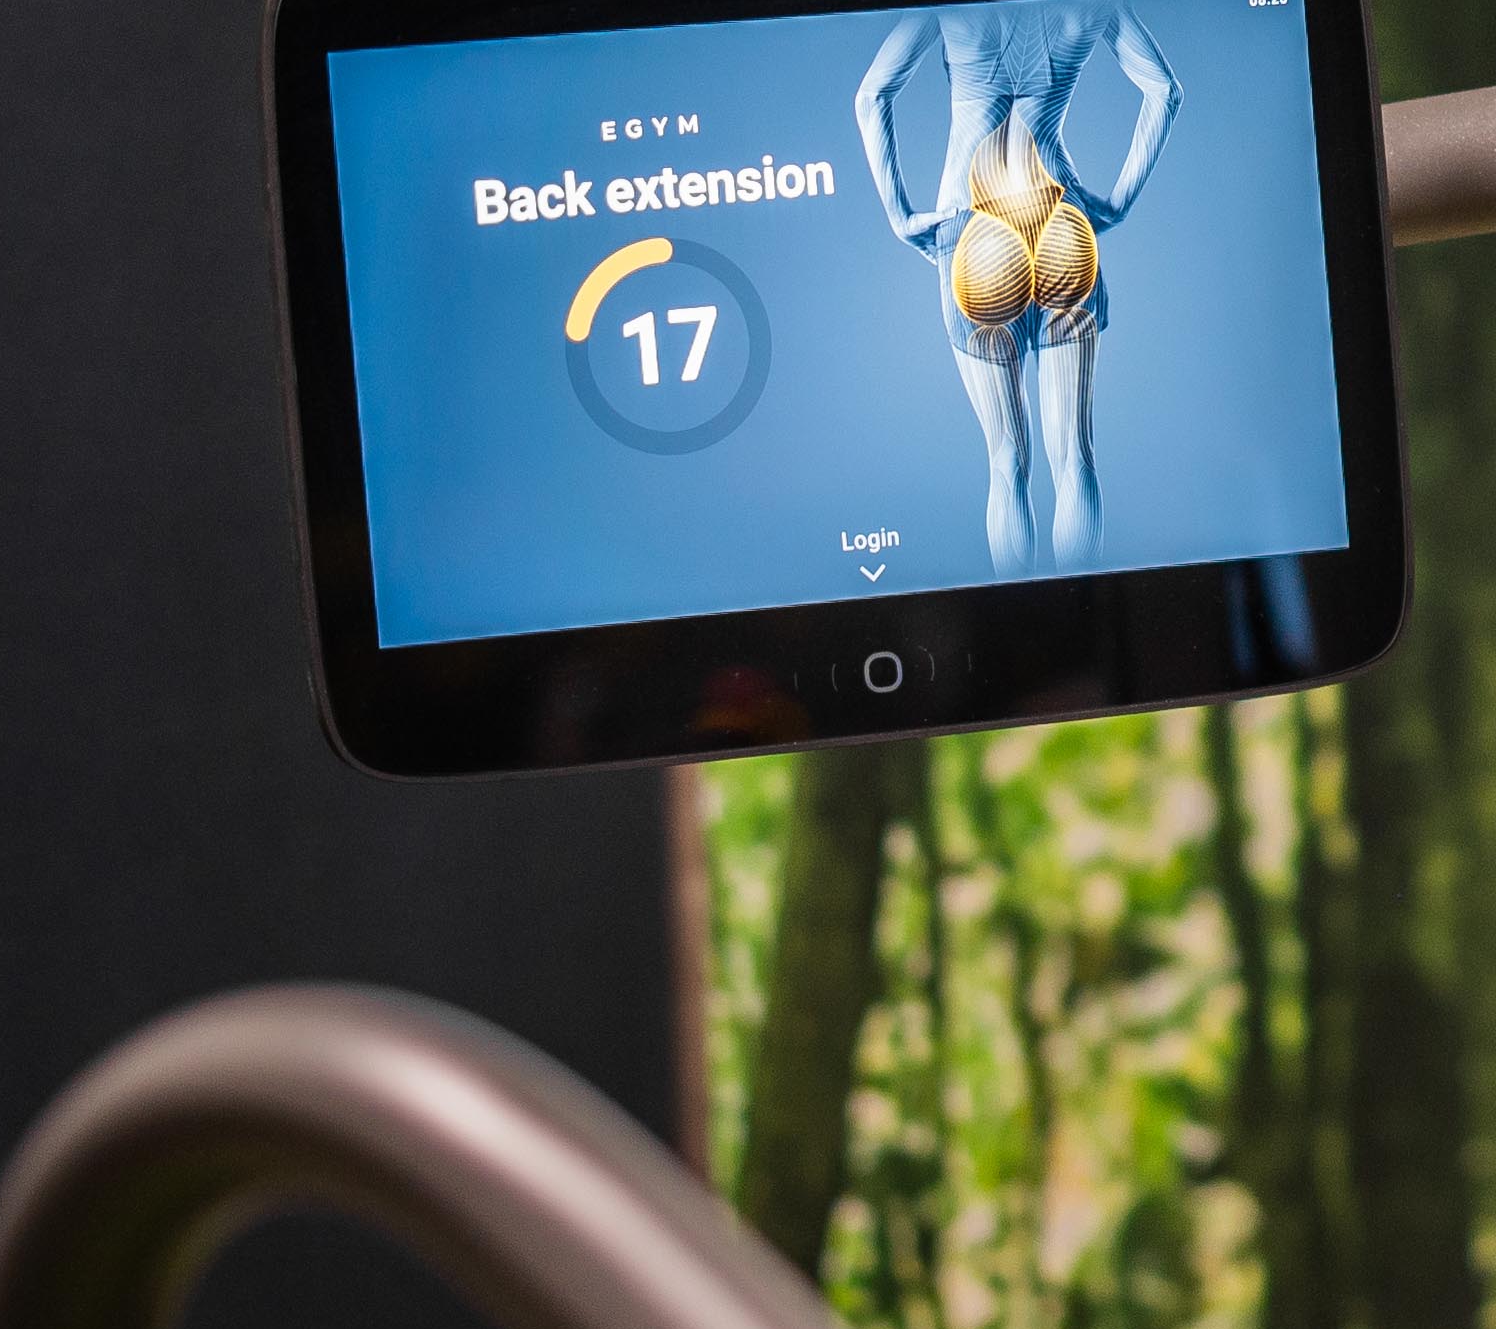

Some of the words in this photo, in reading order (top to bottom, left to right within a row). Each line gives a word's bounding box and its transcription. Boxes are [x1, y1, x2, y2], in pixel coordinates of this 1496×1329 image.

[601, 113, 700, 142] EGYM
[473, 170, 596, 225] Back
[605, 154, 836, 214] extension
[622, 305, 718, 385] 17
[841, 527, 900, 554] Login
